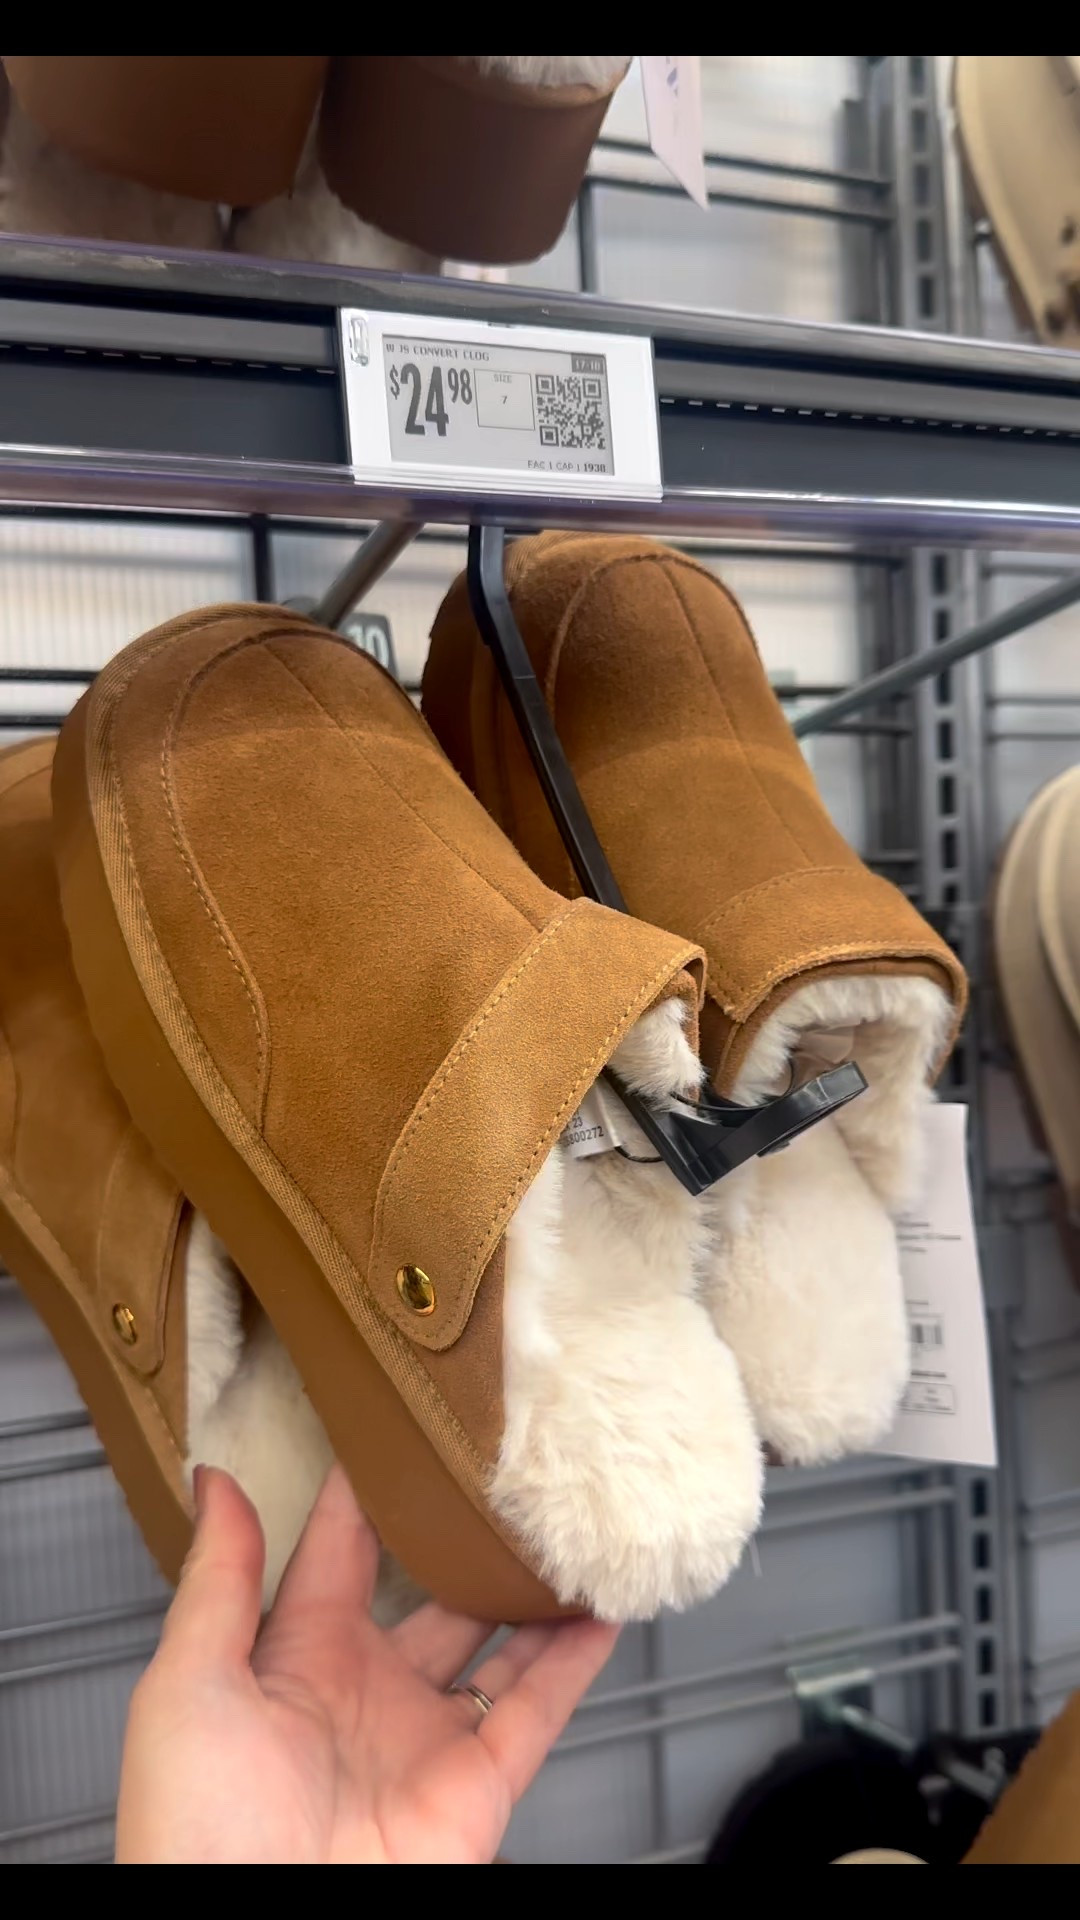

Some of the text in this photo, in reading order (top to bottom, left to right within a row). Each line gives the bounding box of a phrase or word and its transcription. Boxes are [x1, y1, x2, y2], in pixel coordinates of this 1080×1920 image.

[386, 343, 395, 353] W
[413, 346, 459, 359] CONVERT
[463, 351, 490, 361] CLOG
[493, 373, 513, 384] SIZE
[501, 395, 508, 405] 7
[527, 459, 546, 470] FAC
[556, 462, 574, 471] CAP
